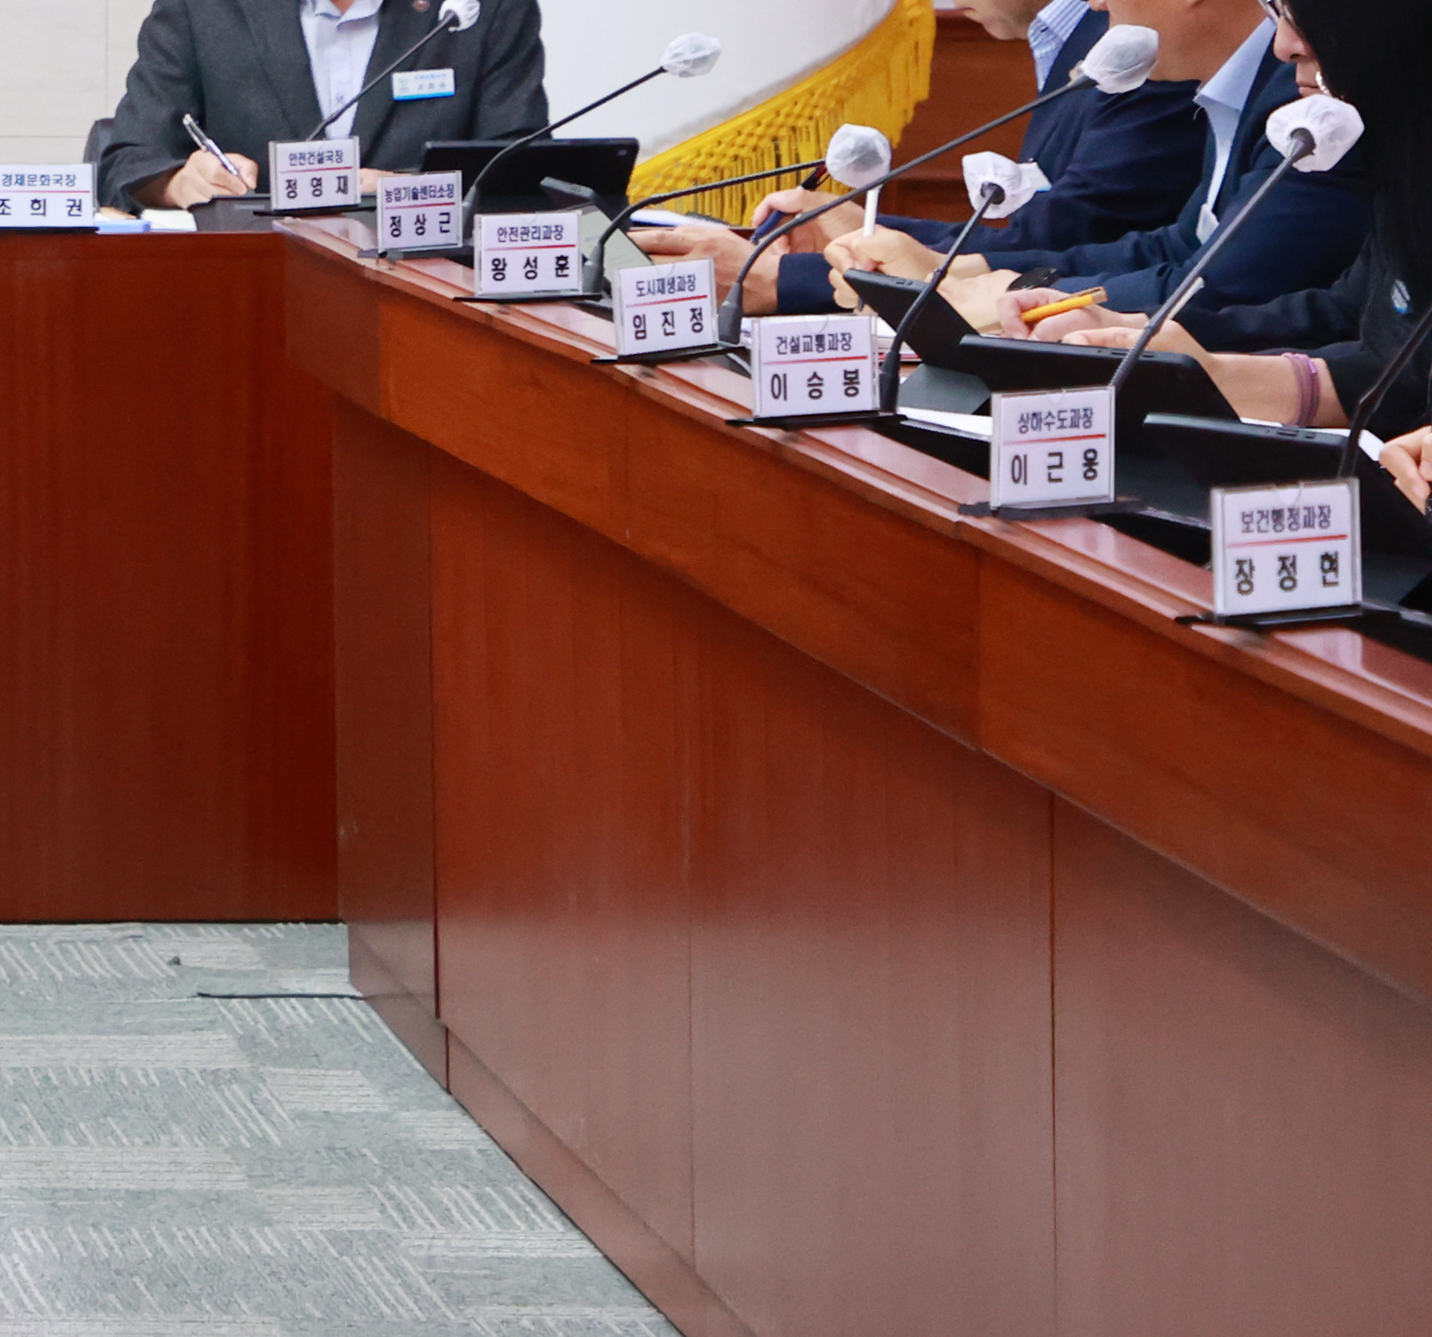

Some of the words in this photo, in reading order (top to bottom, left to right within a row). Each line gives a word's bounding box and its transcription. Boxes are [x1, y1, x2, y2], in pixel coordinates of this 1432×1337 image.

[289, 150, 343, 166] 안전건설국장
[2, 173, 76, 187] 경제문화국장
[286, 175, 348, 199] 정영재
[385, 183, 454, 203] 농업기술센터소장
[390, 212, 451, 238] 정상근
[497, 225, 564, 243] 안전관리과장
[491, 255, 569, 281] 왕성훈
[636, 274, 696, 297] 도시재생과장
[633, 307, 703, 340] 임진정
[776, 332, 852, 355] 건설교통과장
[770, 369, 860, 401] 이승봉
[1018, 408, 1093, 434] 상하수도과장
[1241, 505, 1331, 533] 보건행정과장
[1235, 551, 1339, 595] 장정현
